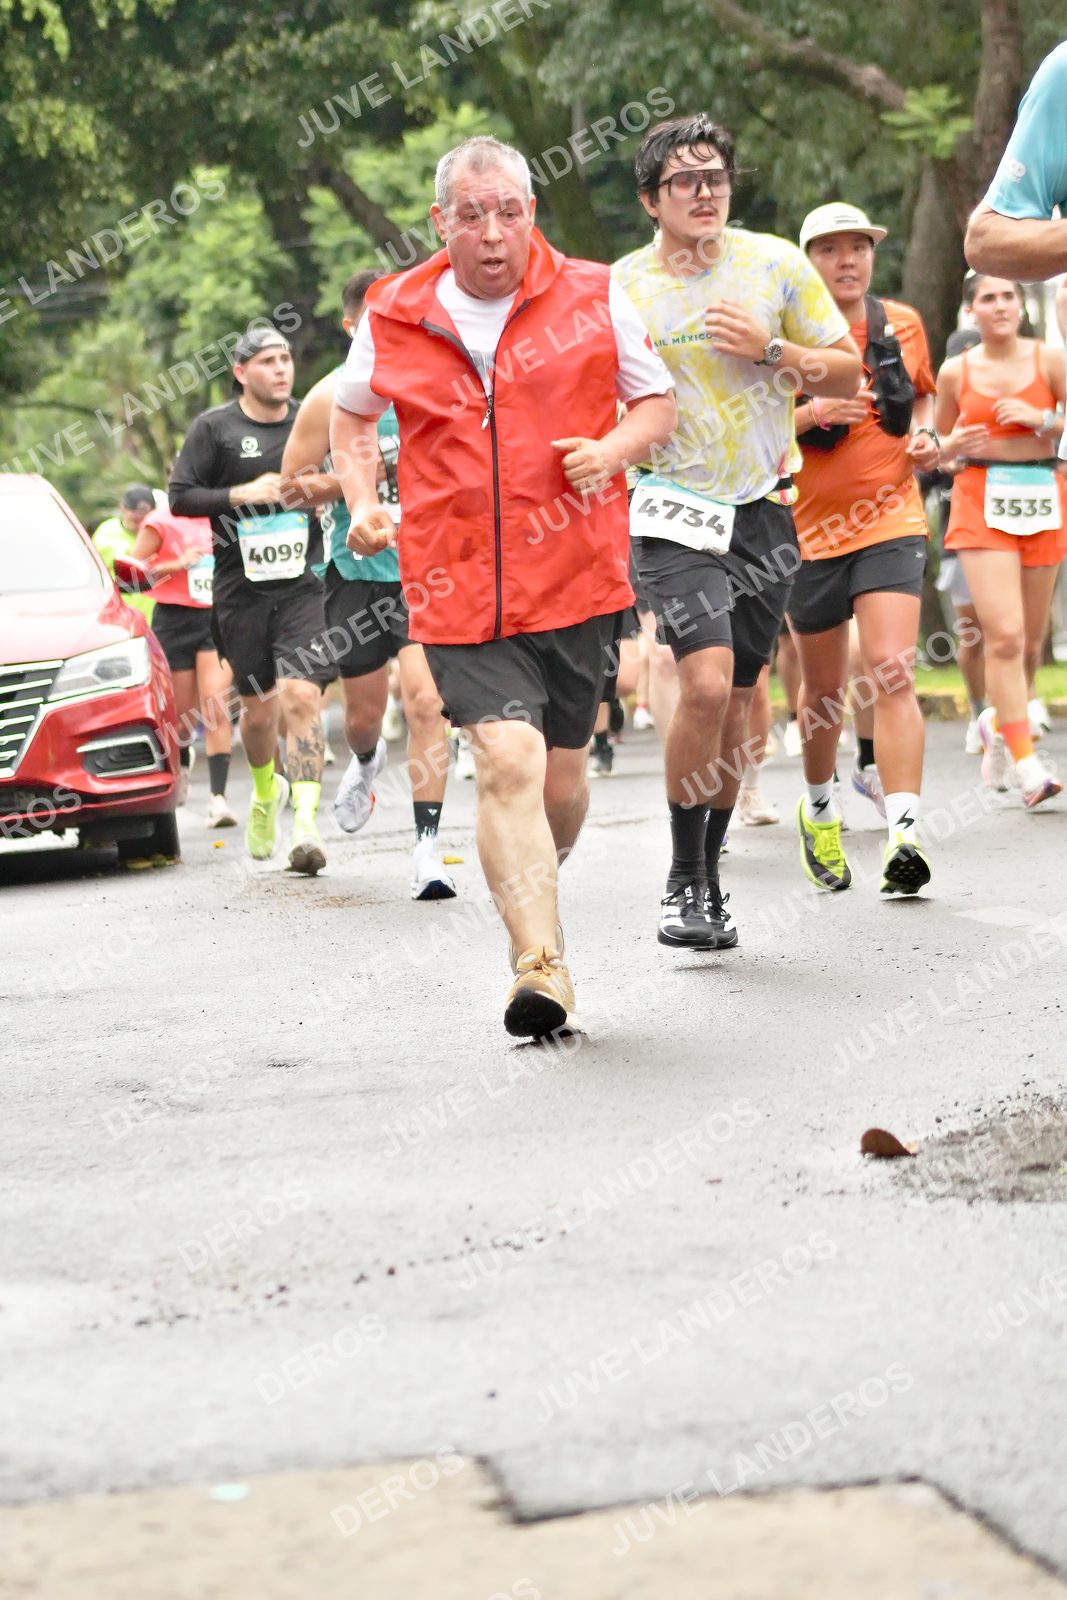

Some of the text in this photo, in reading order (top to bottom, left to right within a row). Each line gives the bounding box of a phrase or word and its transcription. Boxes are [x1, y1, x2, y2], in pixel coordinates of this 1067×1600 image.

[637, 498, 726, 537] 4734
[991, 497, 1053, 517] 3535
[248, 542, 304, 565] 4099
